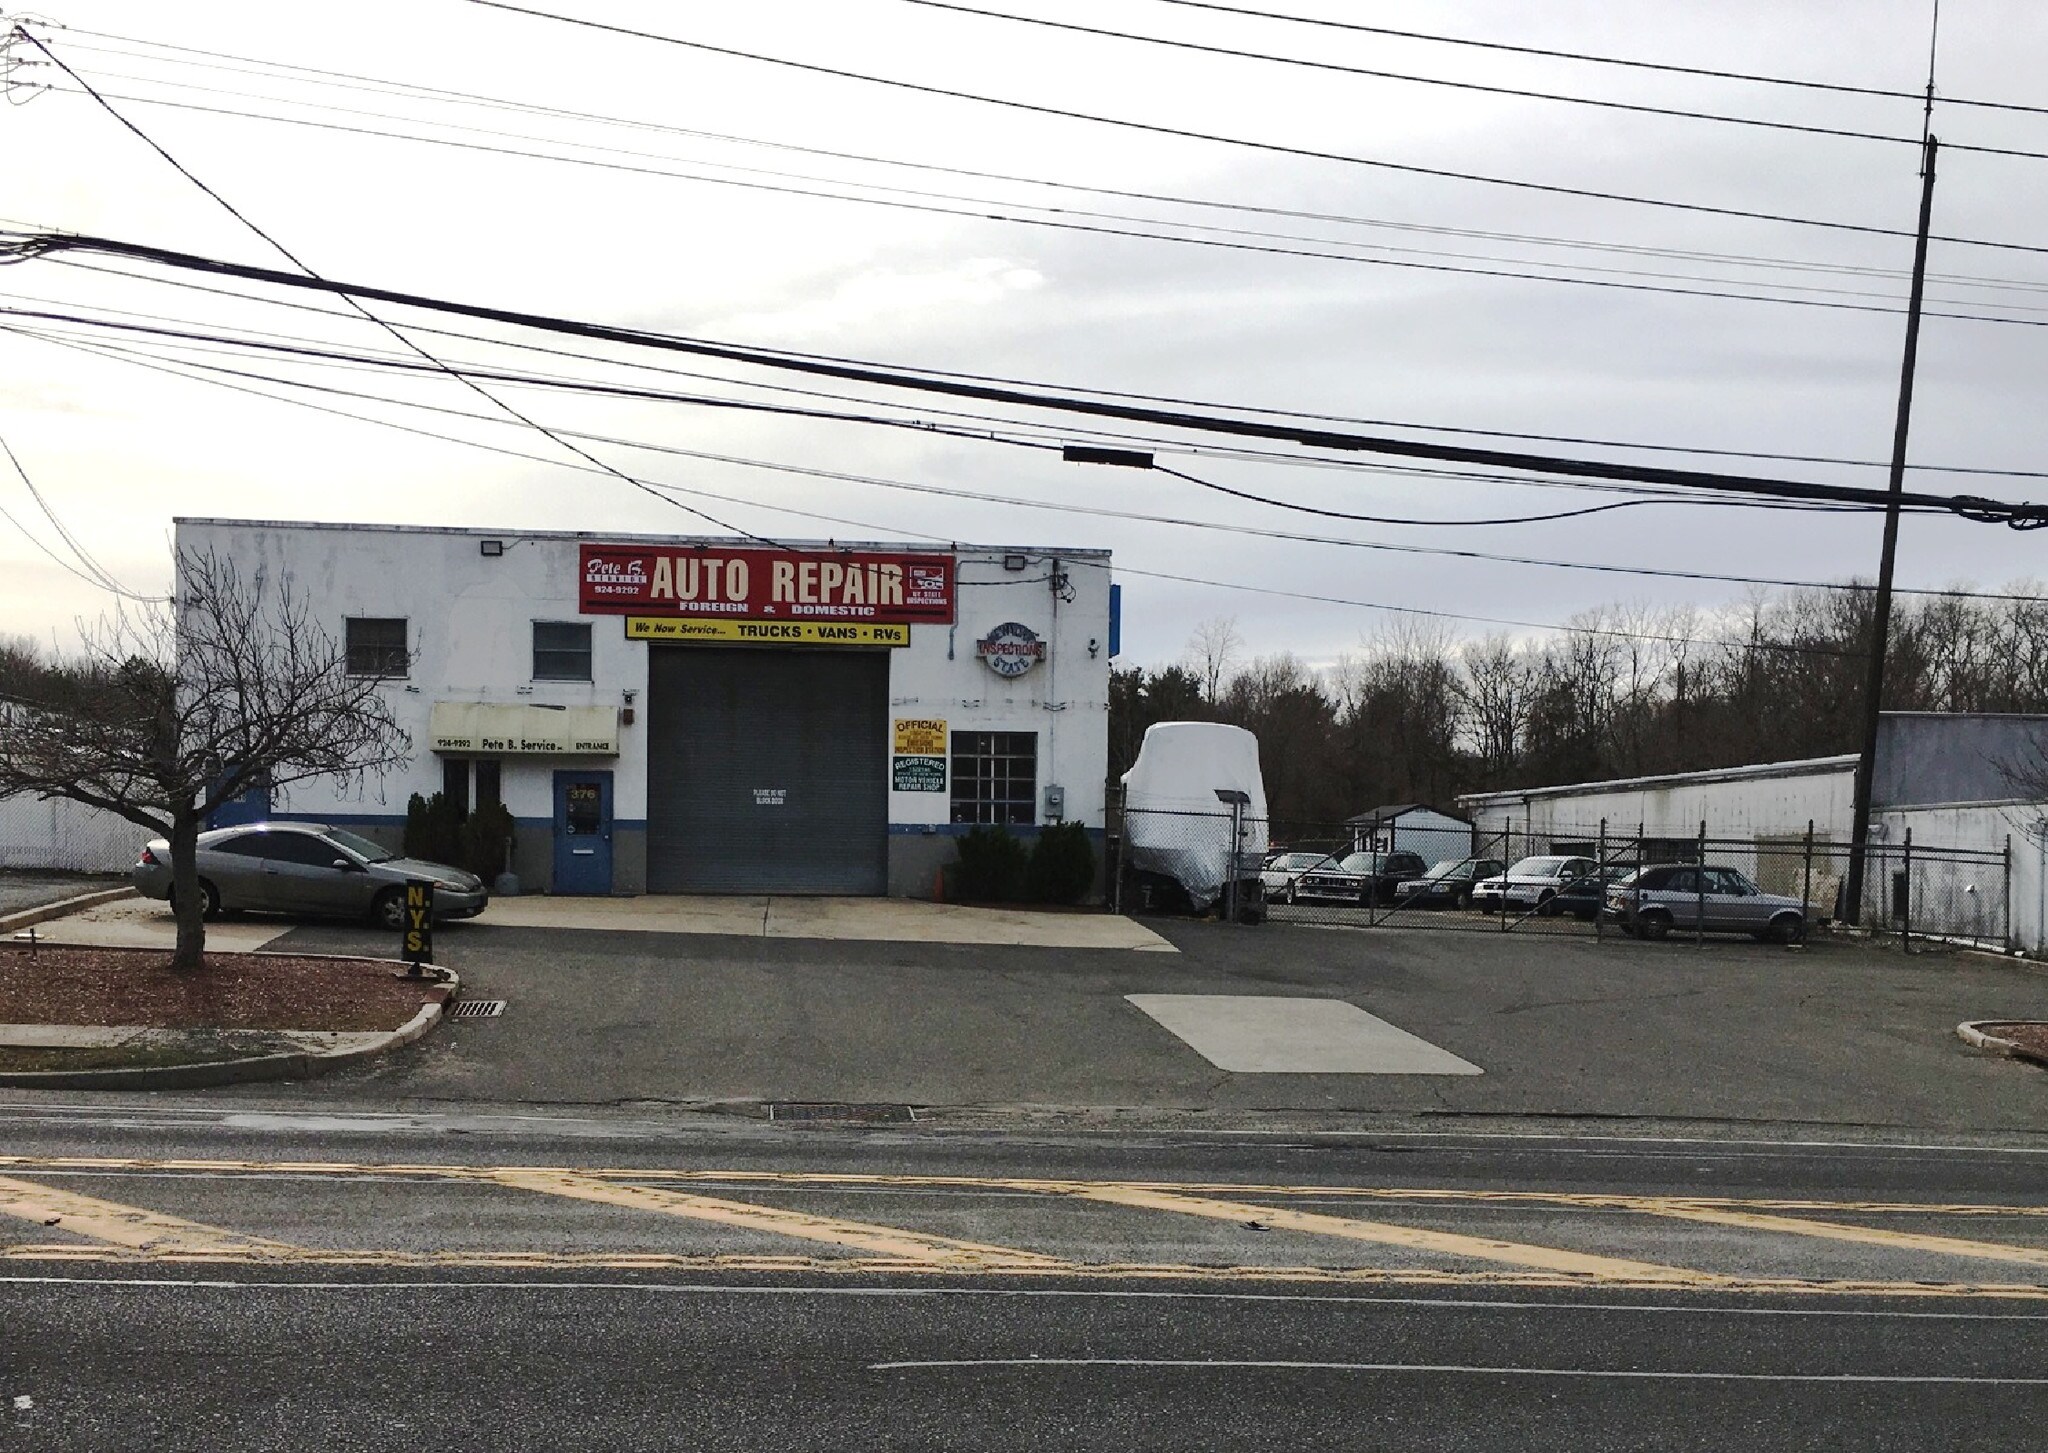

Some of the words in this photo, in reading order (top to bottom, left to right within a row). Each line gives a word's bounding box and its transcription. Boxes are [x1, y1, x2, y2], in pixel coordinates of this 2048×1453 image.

[588, 558, 621, 575] Pete
[650, 556, 749, 602] AUTO
[772, 560, 904, 605] REPAIR
[679, 602, 749, 613] FOREIGN
[791, 604, 876, 616] DOMESTIC
[635, 622, 650, 633] We
[653, 623, 676, 633] Now
[738, 625, 801, 638] TRUCKS
[818, 626, 857, 639] VANS
[873, 628, 901, 641] RVs
[980, 641, 1043, 657] INSPECTIONS
[993, 656, 1029, 673] STATE
[896, 720, 944, 733] OFFICIAL
[482, 738, 504, 750] Pete
[508, 738, 518, 750] B.
[521, 738, 556, 751] Service
[575, 742, 610, 750] ENTRANCE
[895, 757, 945, 770] REGISTERED
[571, 789, 597, 799] 376
